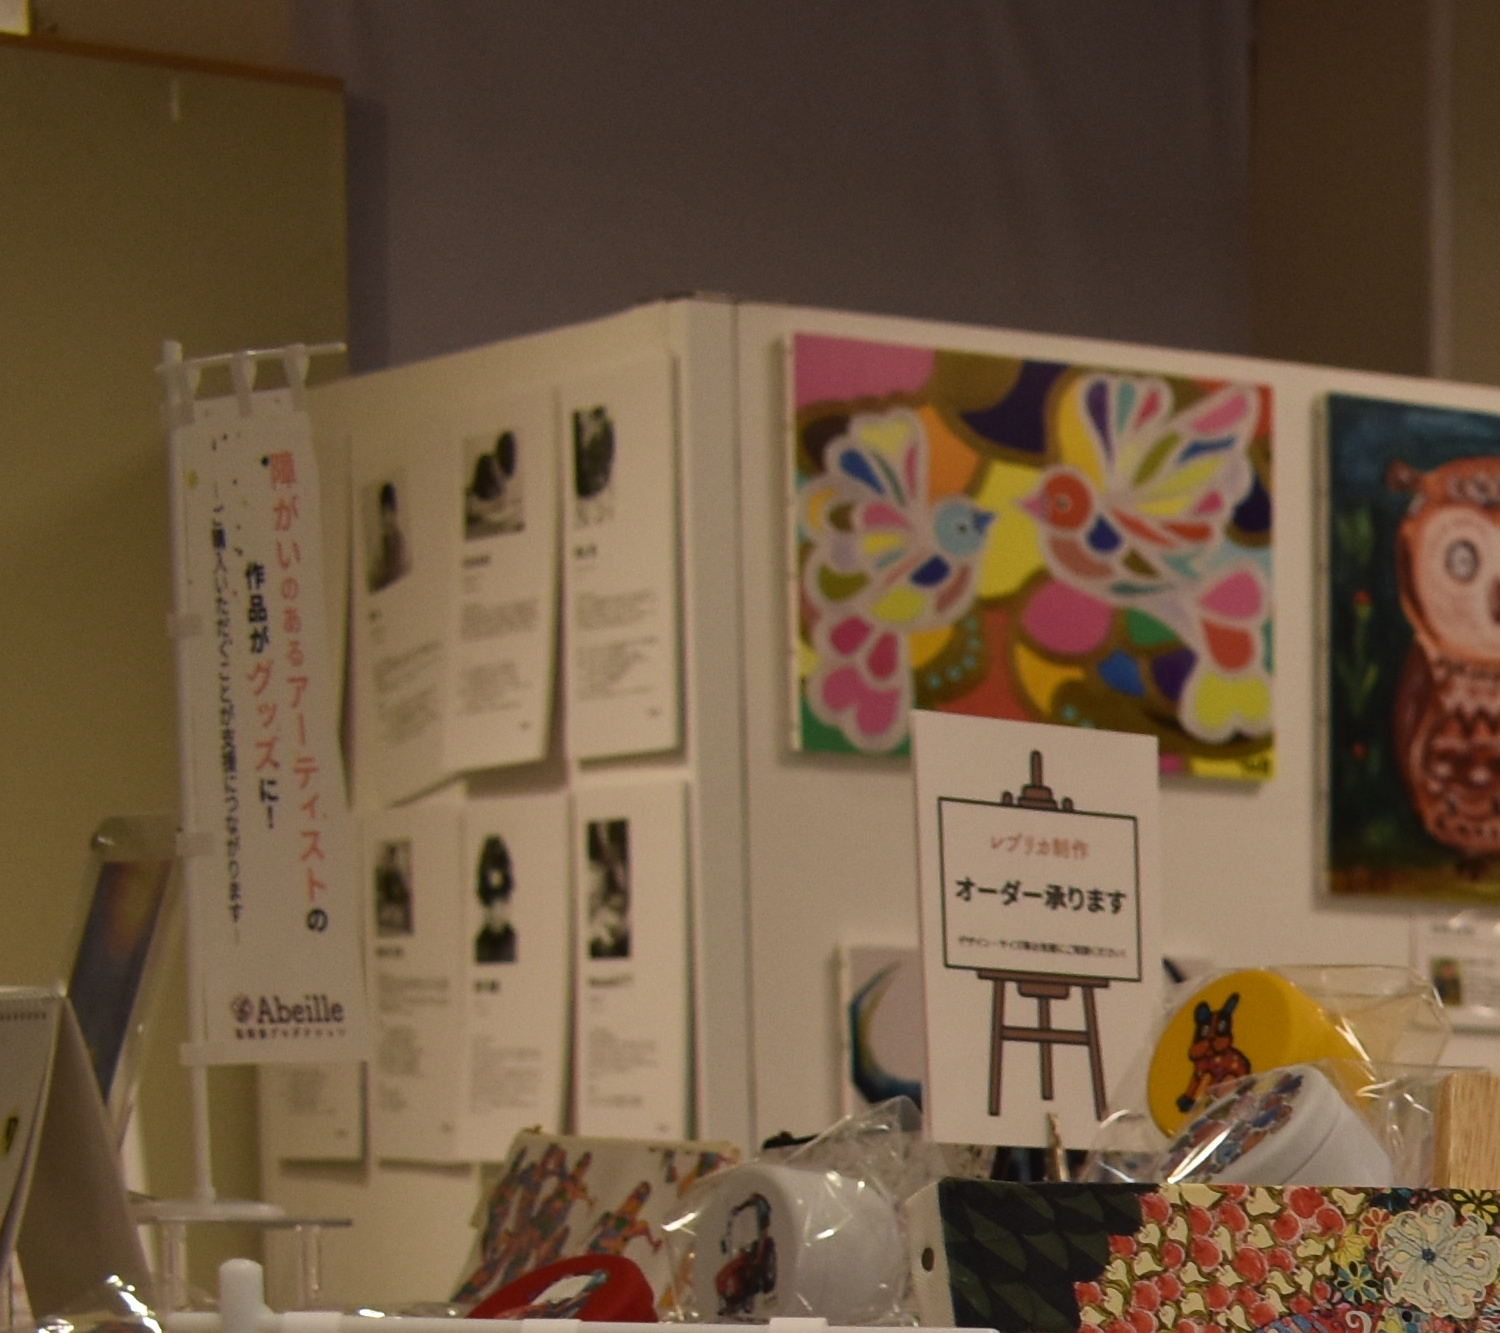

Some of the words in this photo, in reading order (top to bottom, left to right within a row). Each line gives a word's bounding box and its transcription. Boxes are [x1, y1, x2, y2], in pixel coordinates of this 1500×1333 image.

[954, 876, 1128, 915] オーダー承ります
[256, 995, 345, 1024] Abeille
